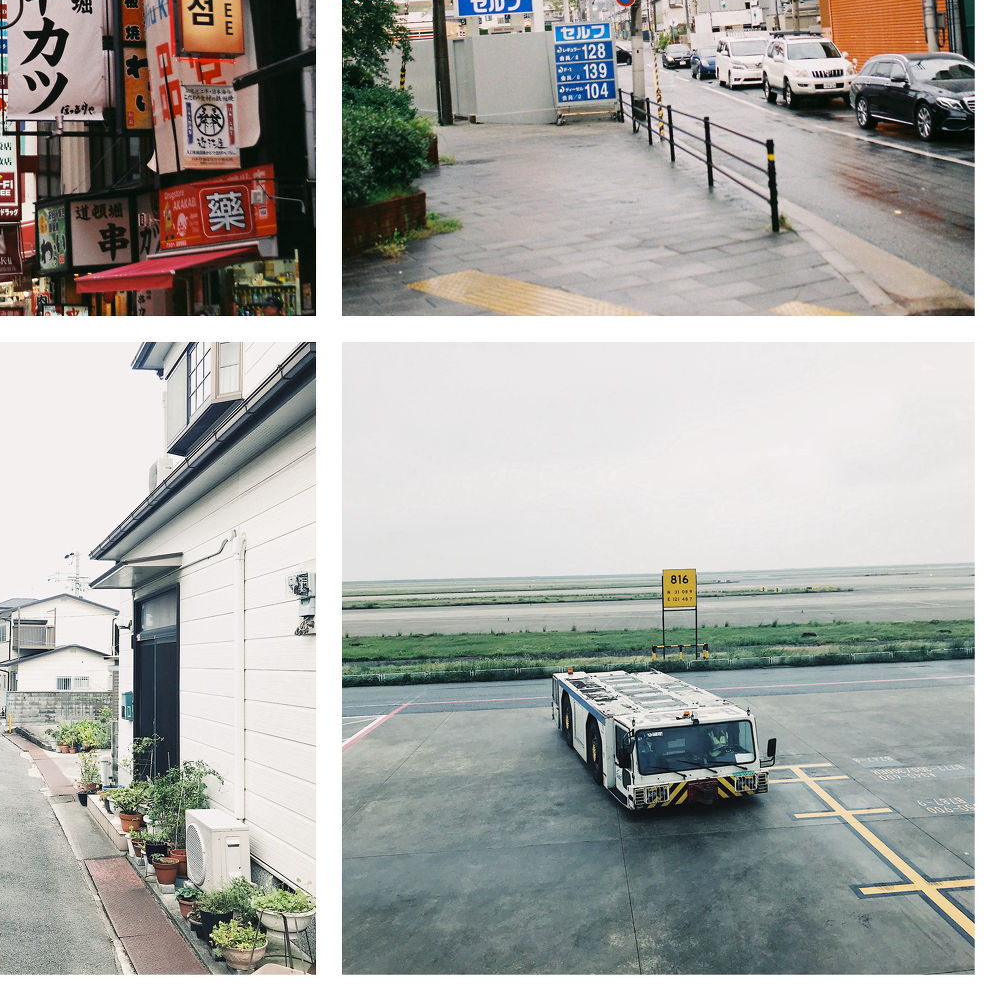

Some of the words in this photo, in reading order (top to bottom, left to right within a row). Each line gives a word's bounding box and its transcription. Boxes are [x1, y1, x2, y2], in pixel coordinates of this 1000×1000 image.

[560, 25, 605, 40] セルフ
[582, 43, 606, 60] 128
[583, 62, 608, 80] 139
[585, 82, 608, 99] 104
[75, 203, 124, 221] 道頓堀
[98, 223, 129, 261] 串
[670, 574, 689, 584] 816
[917, 797, 967, 807] B787-9
